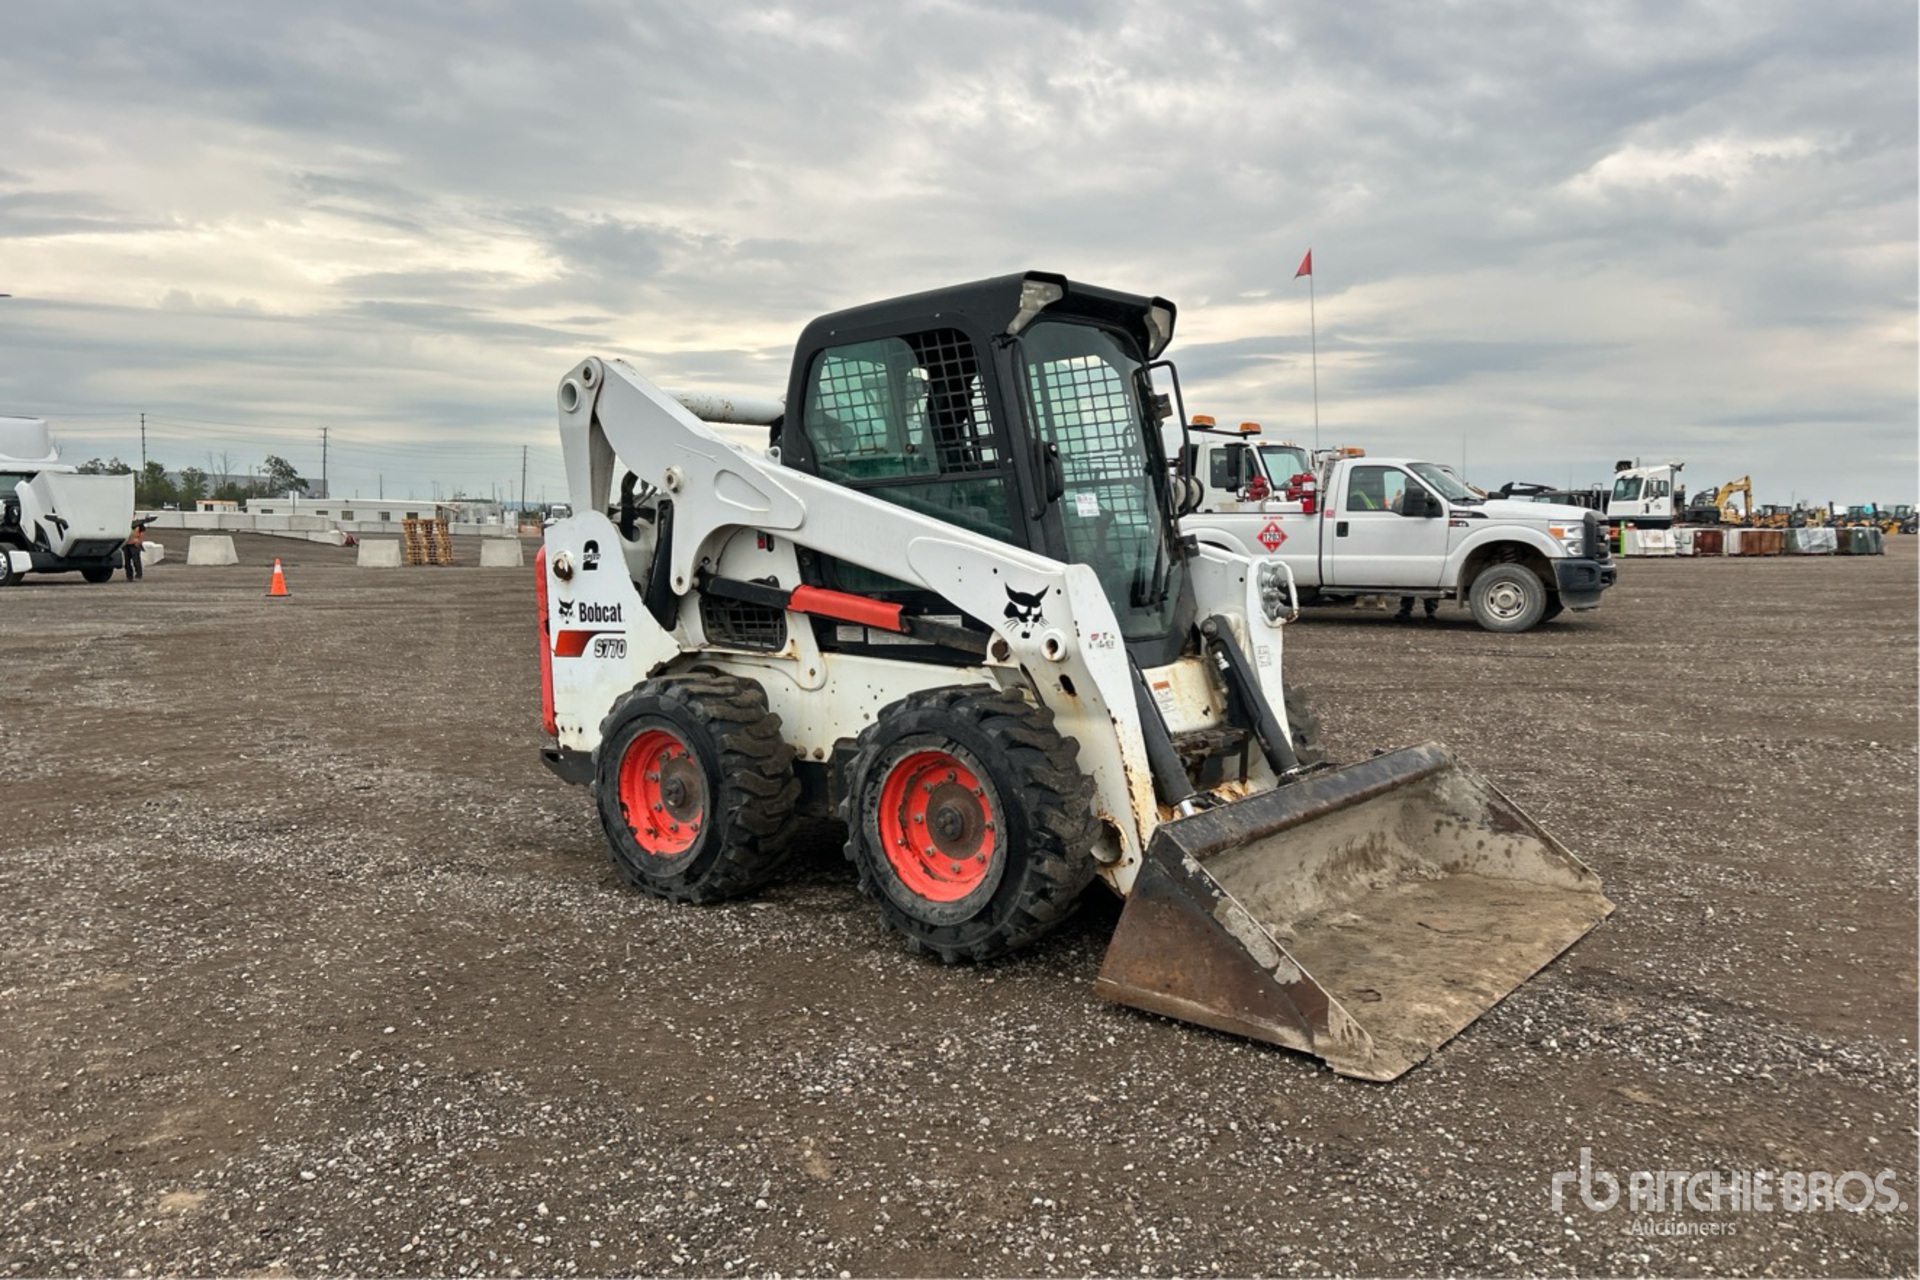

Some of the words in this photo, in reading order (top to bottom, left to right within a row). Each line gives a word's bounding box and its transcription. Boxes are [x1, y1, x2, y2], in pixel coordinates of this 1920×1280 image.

[582, 539, 599, 571] 2
[578, 602, 622, 623] Bobcat
[594, 638, 628, 659] S770
